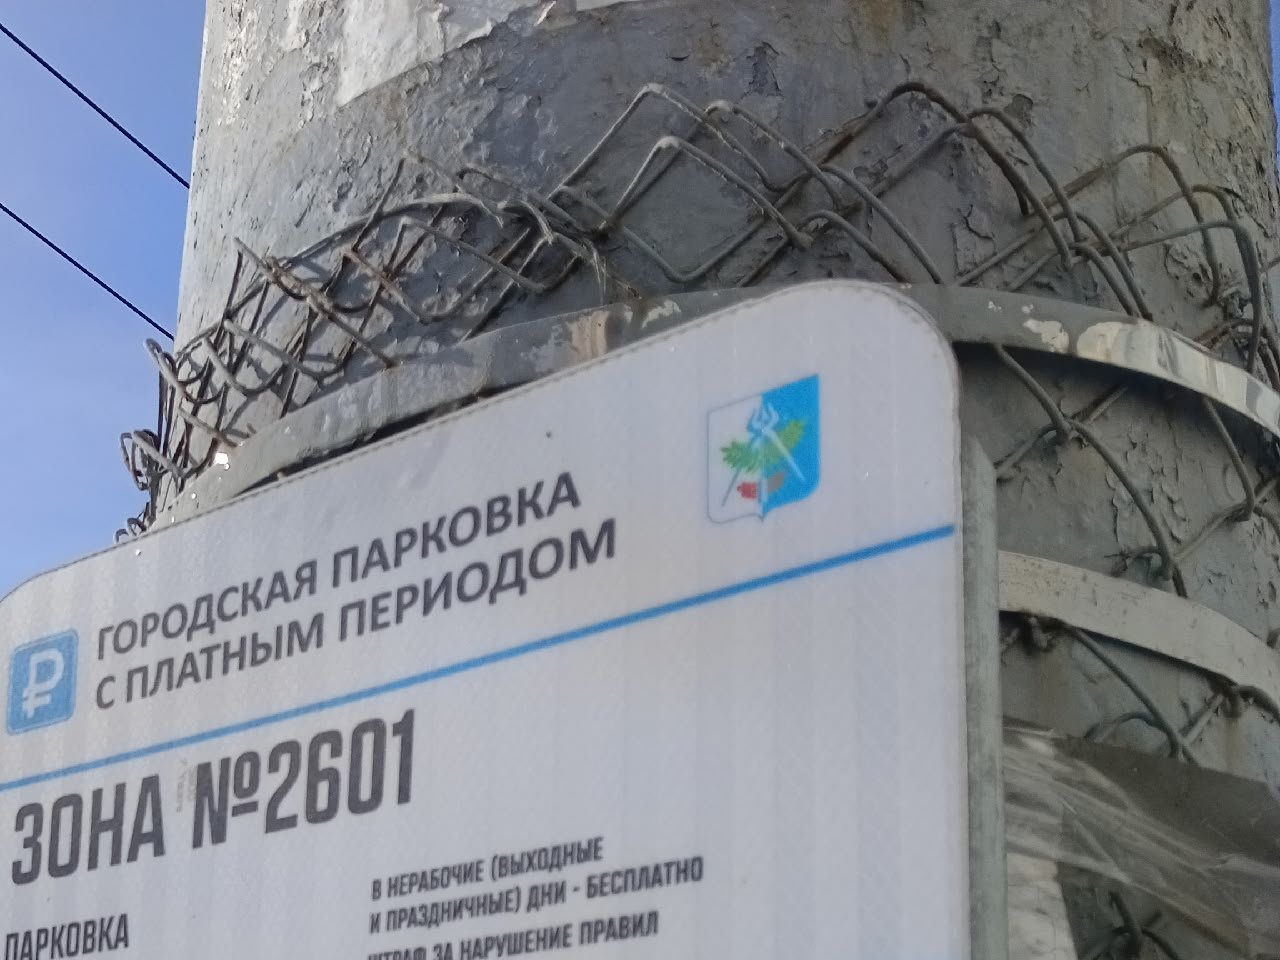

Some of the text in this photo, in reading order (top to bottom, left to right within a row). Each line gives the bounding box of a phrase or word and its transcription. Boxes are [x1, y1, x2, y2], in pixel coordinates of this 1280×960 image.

[95, 519, 616, 710] С ПЛАТНЫМ ПЕРИОДОМ
[97, 473, 581, 661] ГОРОДСКАЯ ПАРКОВКА
[11, 708, 415, 886] ЗОНА №2601
[370, 912, 381, 934] И
[386, 886, 522, 932] ПРАЗДНИЧНЫЕ)
[526, 880, 567, 913] ДНИ
[586, 856, 704, 899] БЕСПЛАТНО
[371, 836, 603, 902] В НЕРАБОЧИЕ (ВЫХОДНЫЕ
[579, 910, 659, 945] ПРАВИЛ
